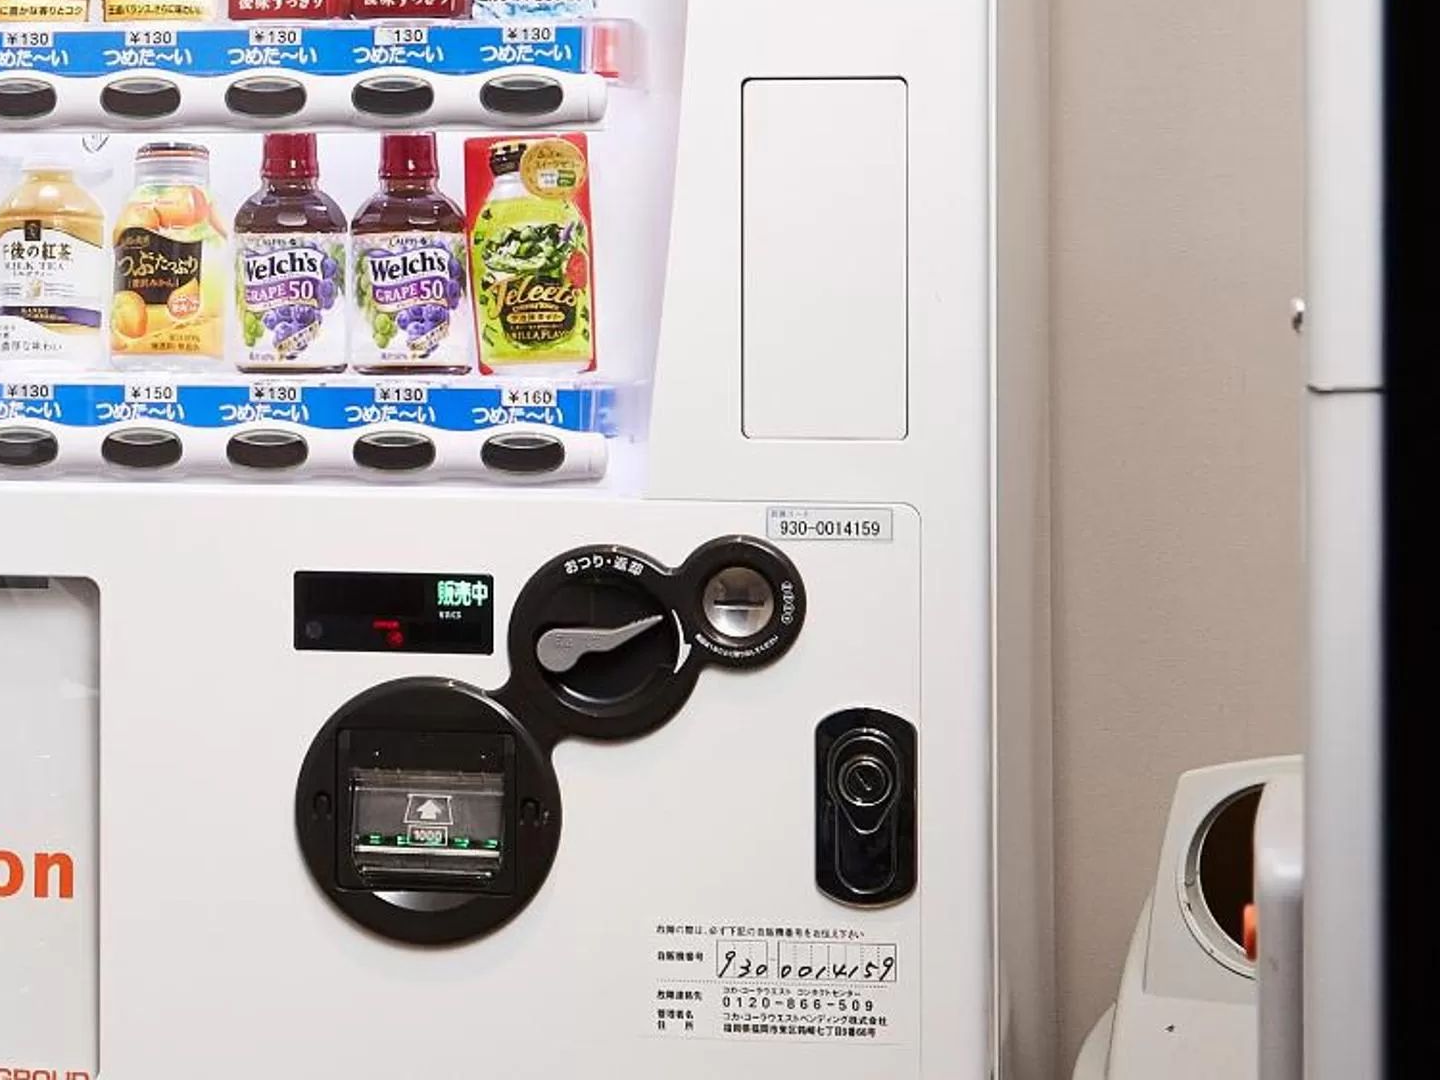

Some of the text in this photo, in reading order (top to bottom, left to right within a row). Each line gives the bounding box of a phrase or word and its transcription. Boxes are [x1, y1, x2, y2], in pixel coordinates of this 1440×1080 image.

[7, 33, 49, 46] ¥130
[129, 31, 172, 45] ¥130
[255, 30, 297, 44] ¥130
[394, 29, 424, 43] 130
[506, 28, 551, 41] ¥130
[370, 253, 448, 281] Welch's
[289, 280, 314, 300] 50
[375, 279, 444, 302] GRAPE 50
[8, 384, 49, 398] ¥130
[131, 386, 172, 400] ¥150
[254, 386, 297, 401] ¥130
[380, 388, 424, 402] ¥130
[508, 390, 552, 404] ¥160
[780, 520, 880, 536] 930-0014159
[437, 580, 488, 606] 販売中
[718, 951, 894, 982] 930 0014159
[723, 996, 873, 1011] 0120-866-509
